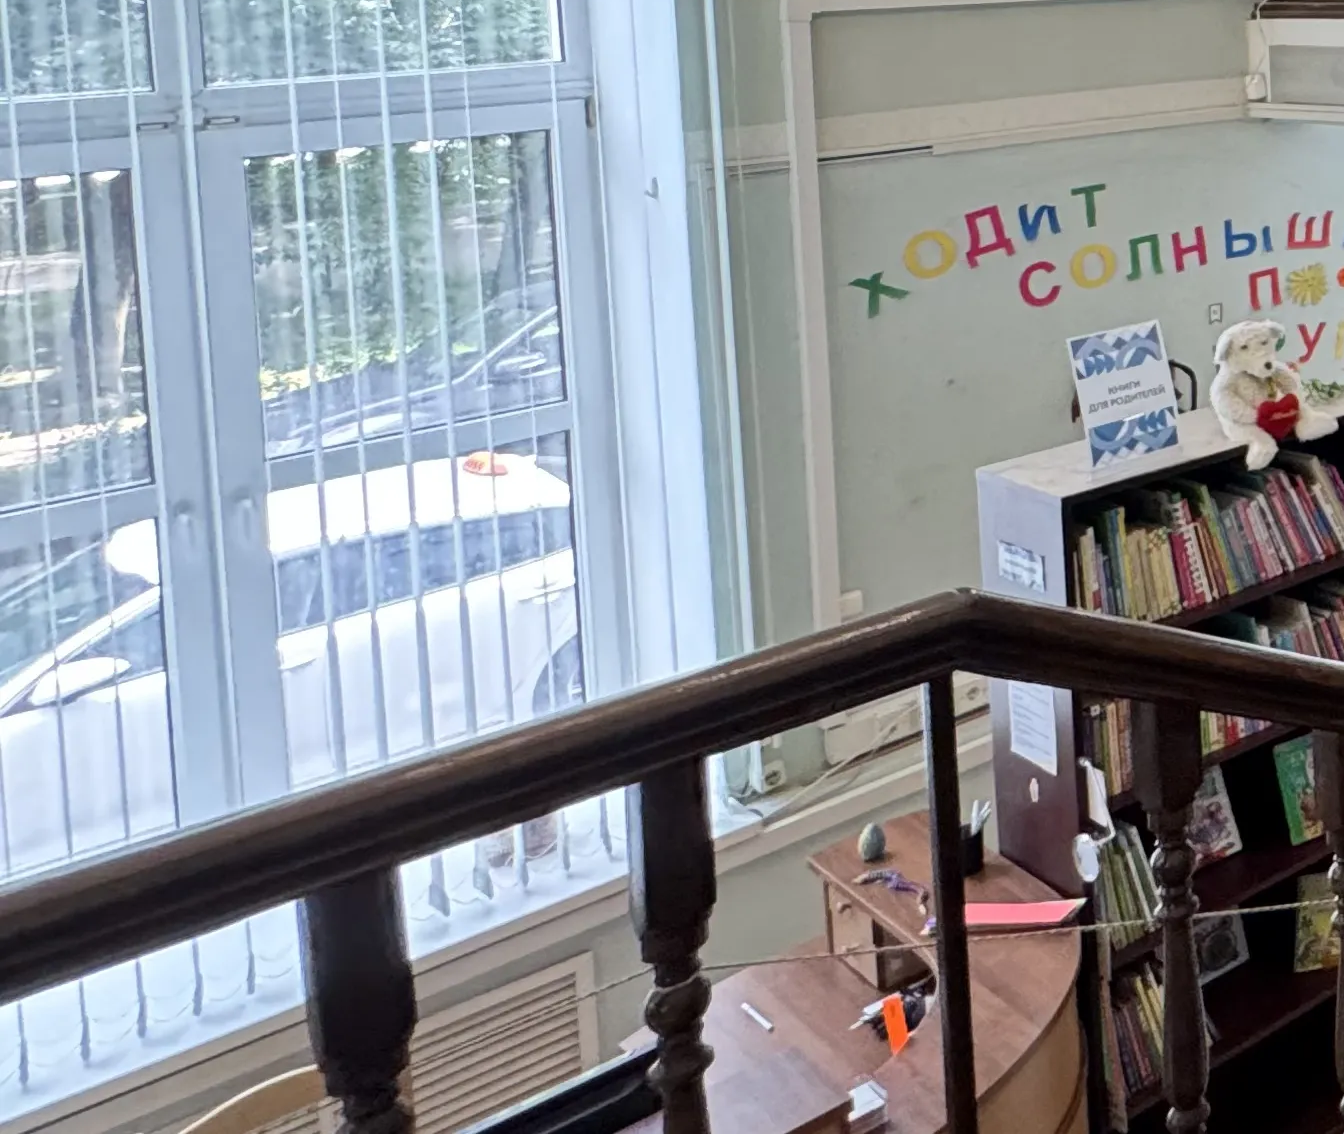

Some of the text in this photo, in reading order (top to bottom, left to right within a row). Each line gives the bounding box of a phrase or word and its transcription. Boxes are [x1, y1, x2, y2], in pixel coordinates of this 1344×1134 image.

[848, 183, 1107, 319] ХОДИТ
[1088, 384, 1166, 415] ДЛЯ РОДИТЕЛЕЙ
[1108, 380, 1141, 395] КНИГИ
